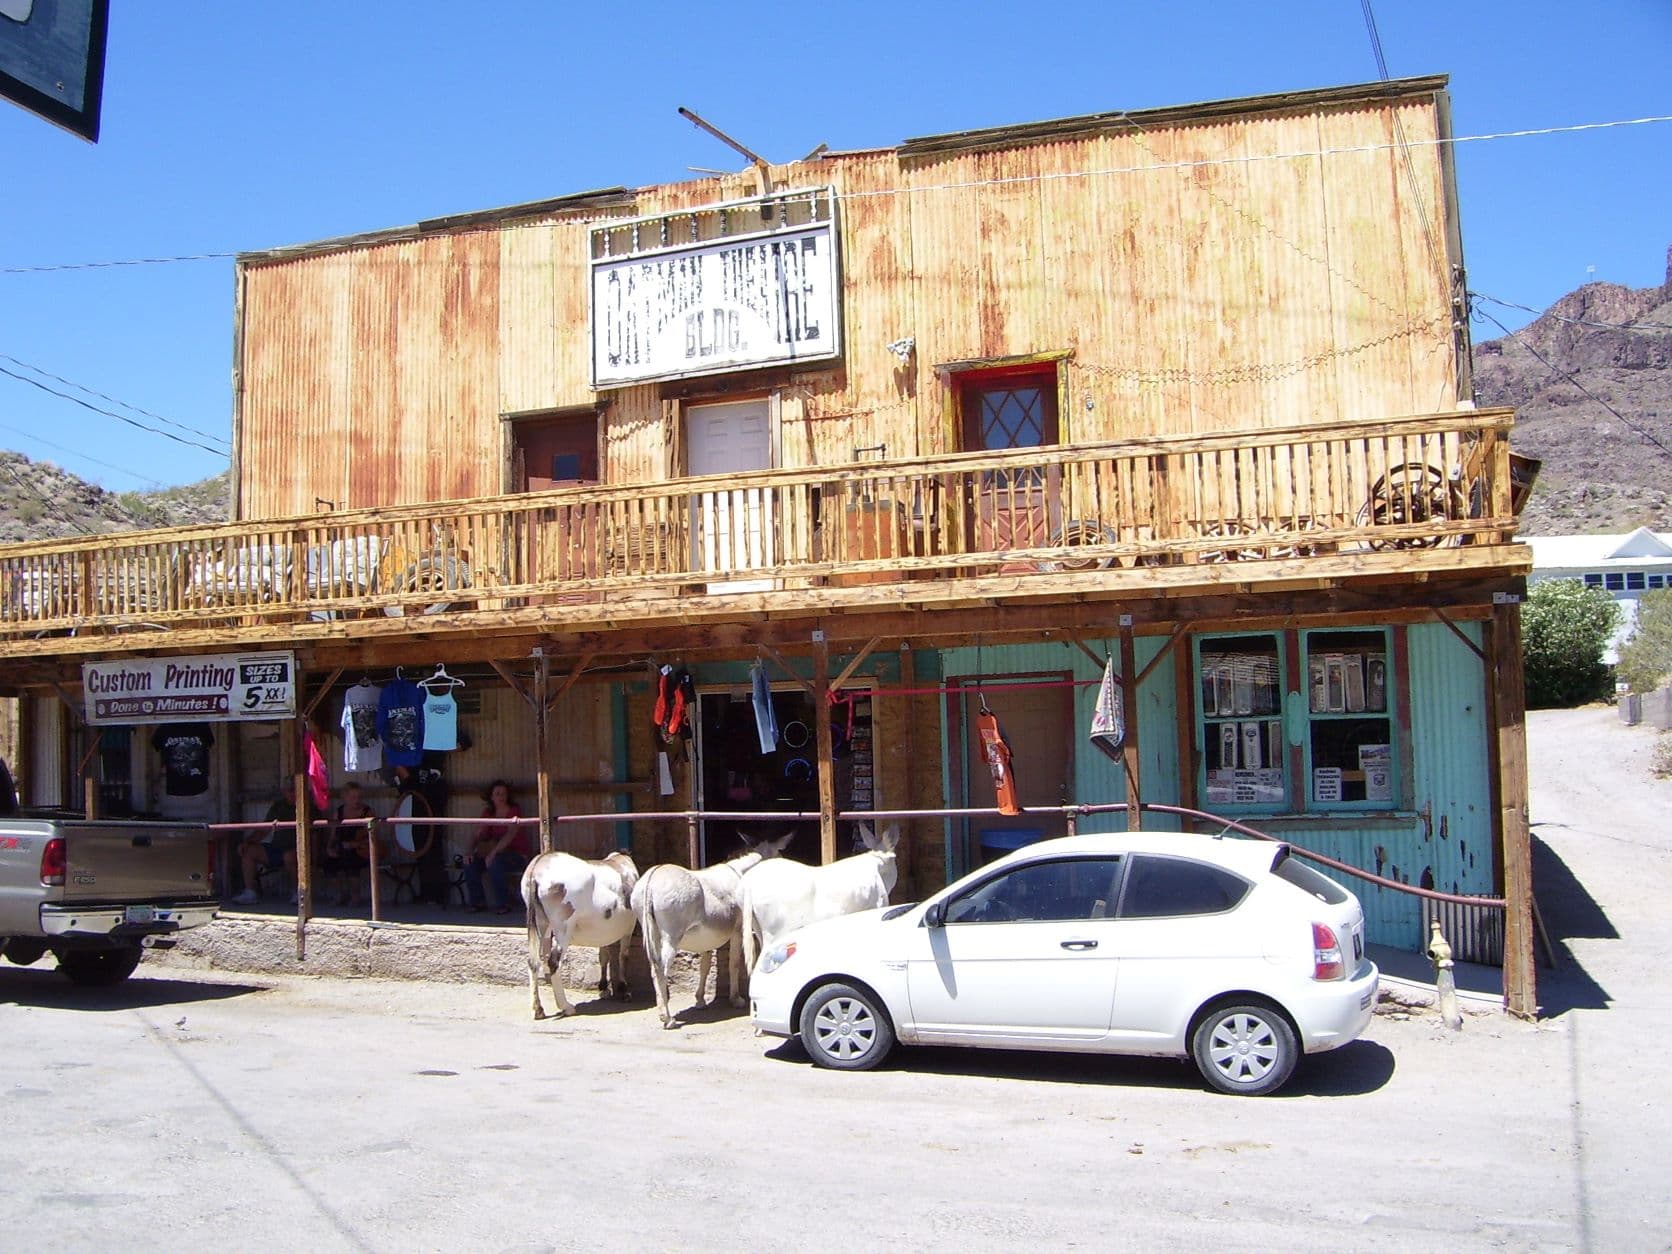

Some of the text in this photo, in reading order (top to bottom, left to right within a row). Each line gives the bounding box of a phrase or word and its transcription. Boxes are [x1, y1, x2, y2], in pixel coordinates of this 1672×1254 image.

[685, 308, 749, 360] BLDG.
[88, 664, 236, 693] Custom Printing
[246, 664, 282, 676] SIZES
[265, 675, 279, 683] TO
[243, 685, 263, 709] 5
[110, 701, 139, 713] Done
